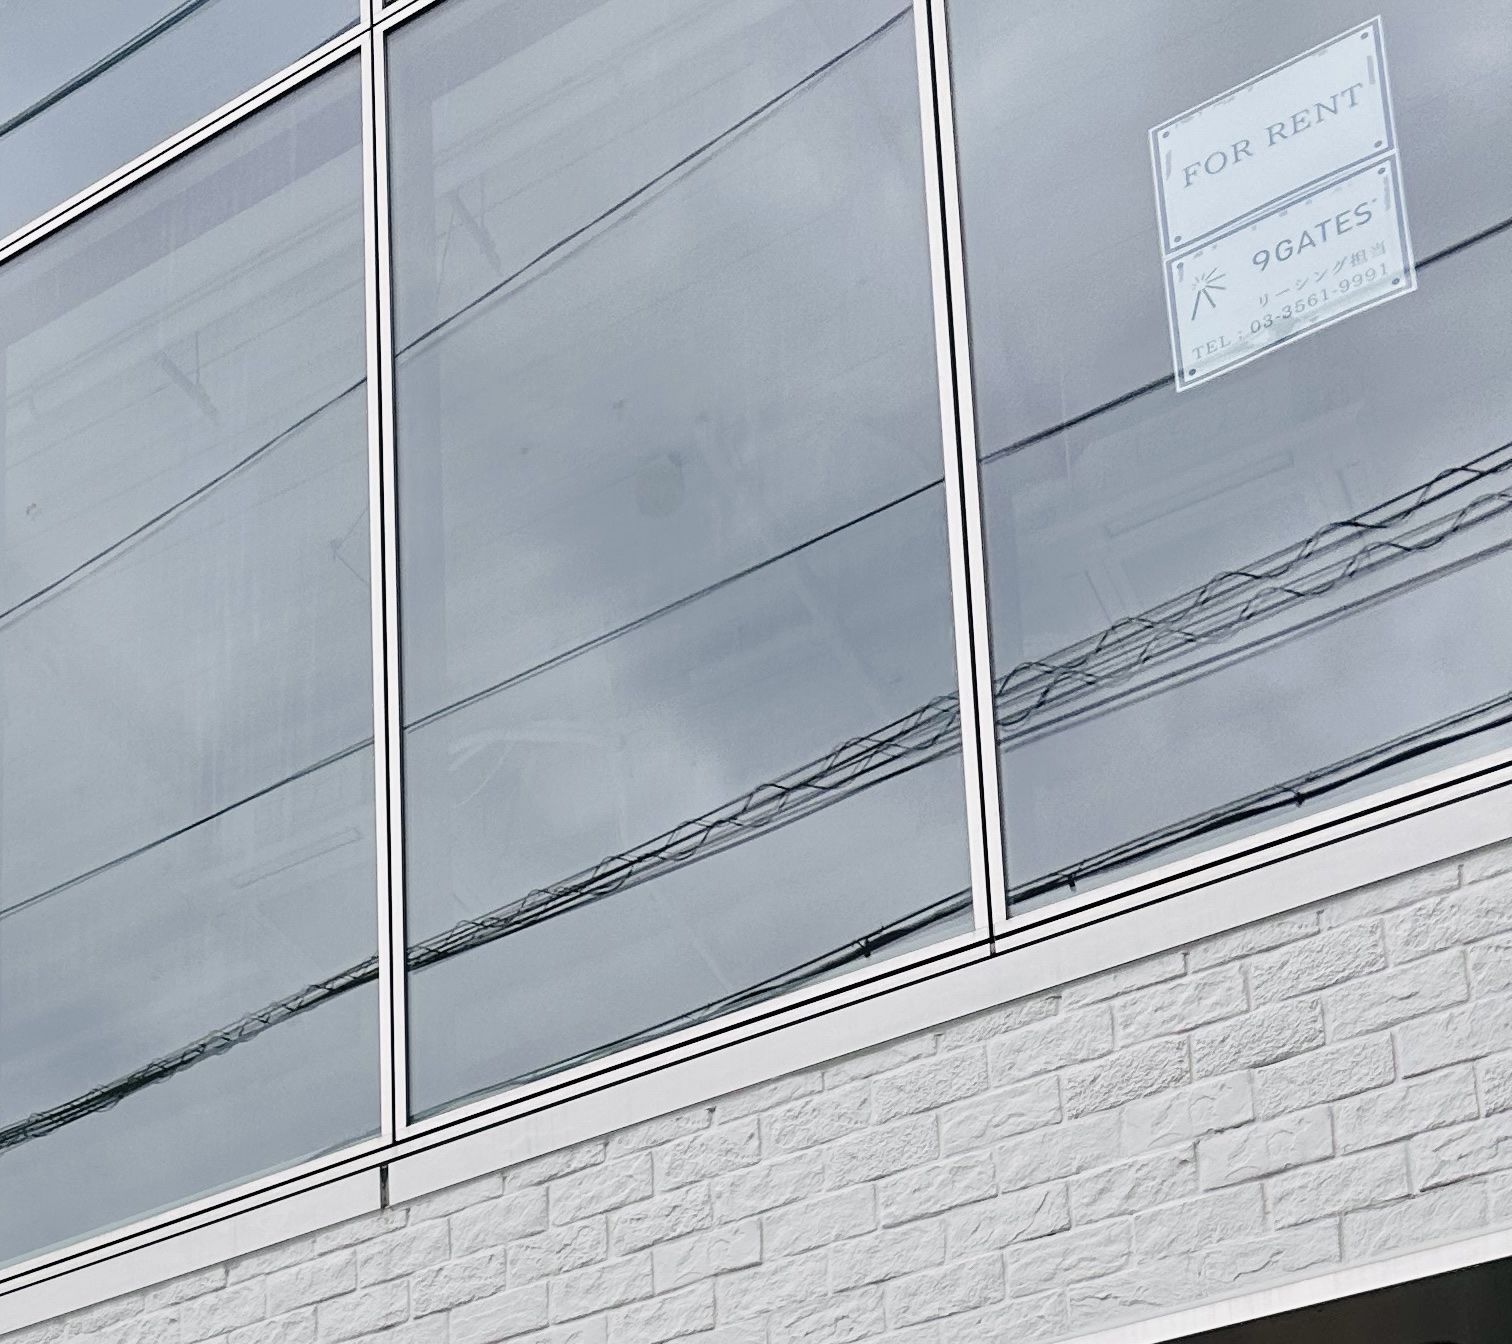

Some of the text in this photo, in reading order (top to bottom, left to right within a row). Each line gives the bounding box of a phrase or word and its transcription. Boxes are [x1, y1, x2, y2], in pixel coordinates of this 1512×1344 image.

[1183, 82, 1363, 188] FOR RENT
[1252, 200, 1374, 272] 9GATES
[1250, 263, 1388, 334] 03-3561-9991
